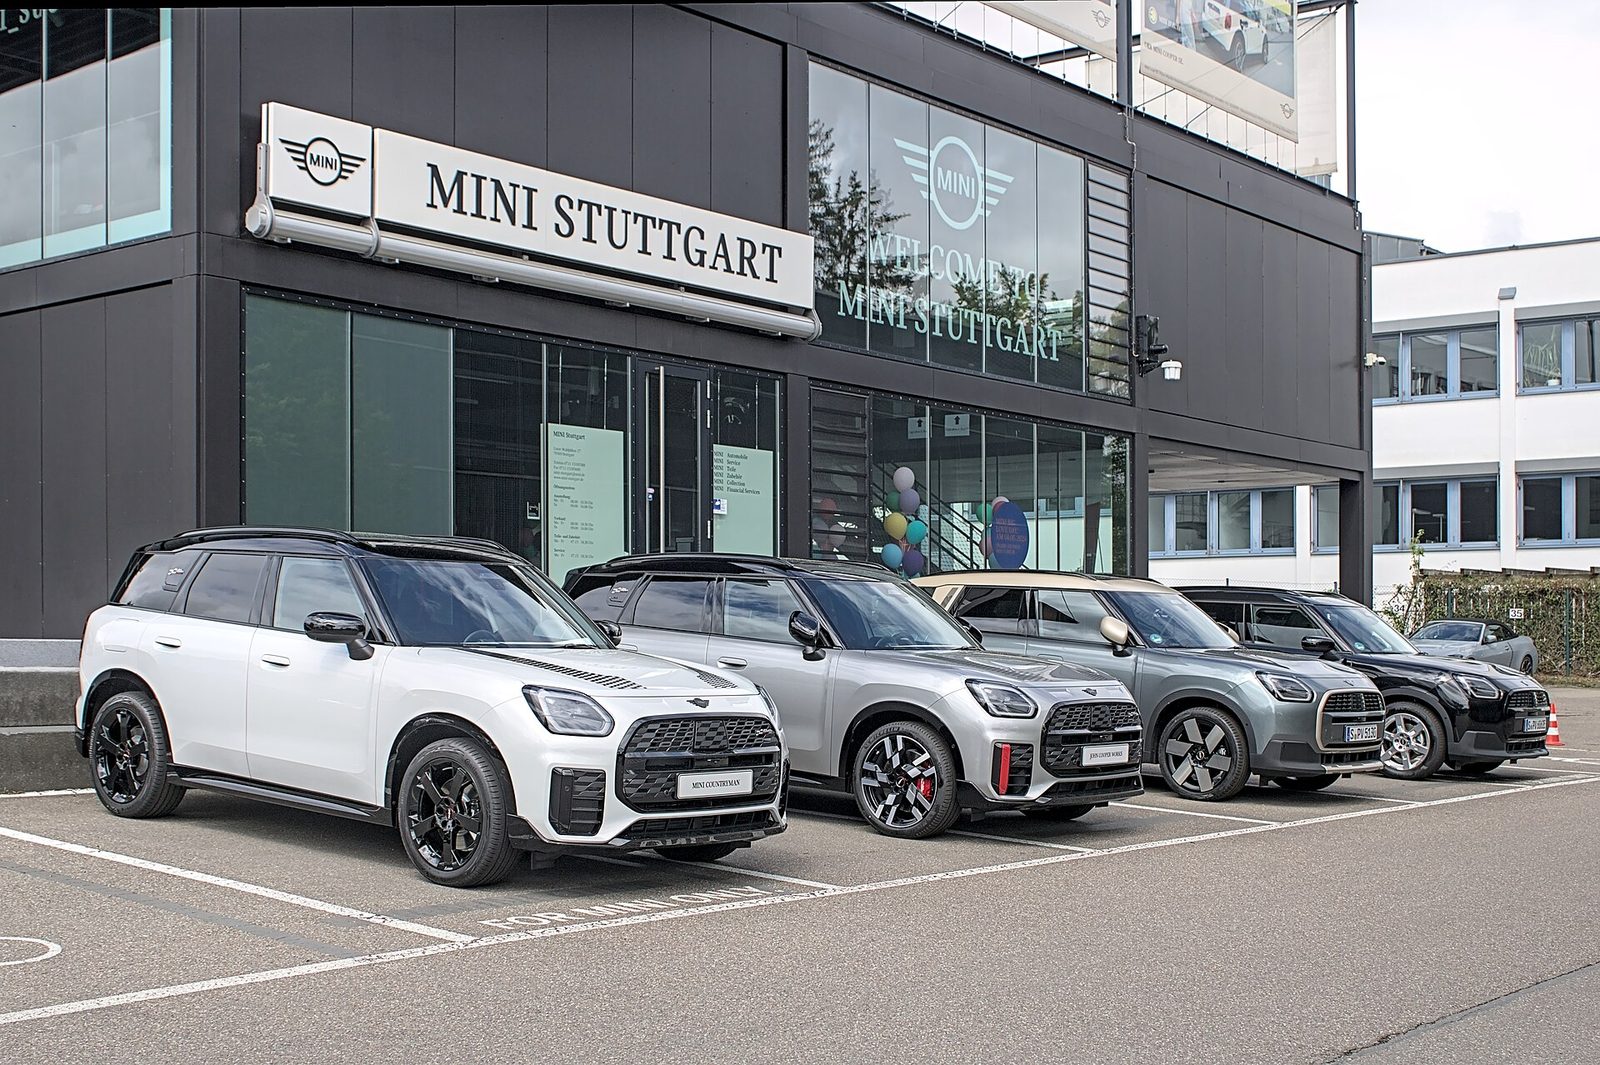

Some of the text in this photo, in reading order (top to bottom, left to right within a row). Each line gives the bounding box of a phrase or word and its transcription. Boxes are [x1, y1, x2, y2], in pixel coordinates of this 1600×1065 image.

[309, 153, 338, 171] MINI
[937, 166, 975, 200] MINI
[426, 162, 783, 284] MINI STUTTGART
[869, 231, 1042, 305] WELCOME TO
[837, 280, 1062, 362] MINI STUTTGART
[566, 432, 585, 441] Stuttgart
[727, 452, 748, 460] Automobile
[727, 486, 744, 494] Financial
[1510, 610, 1522, 618] 35
[706, 779, 740, 788] COUNTRYMAN
[478, 886, 773, 931] FOR MINI ONLY
